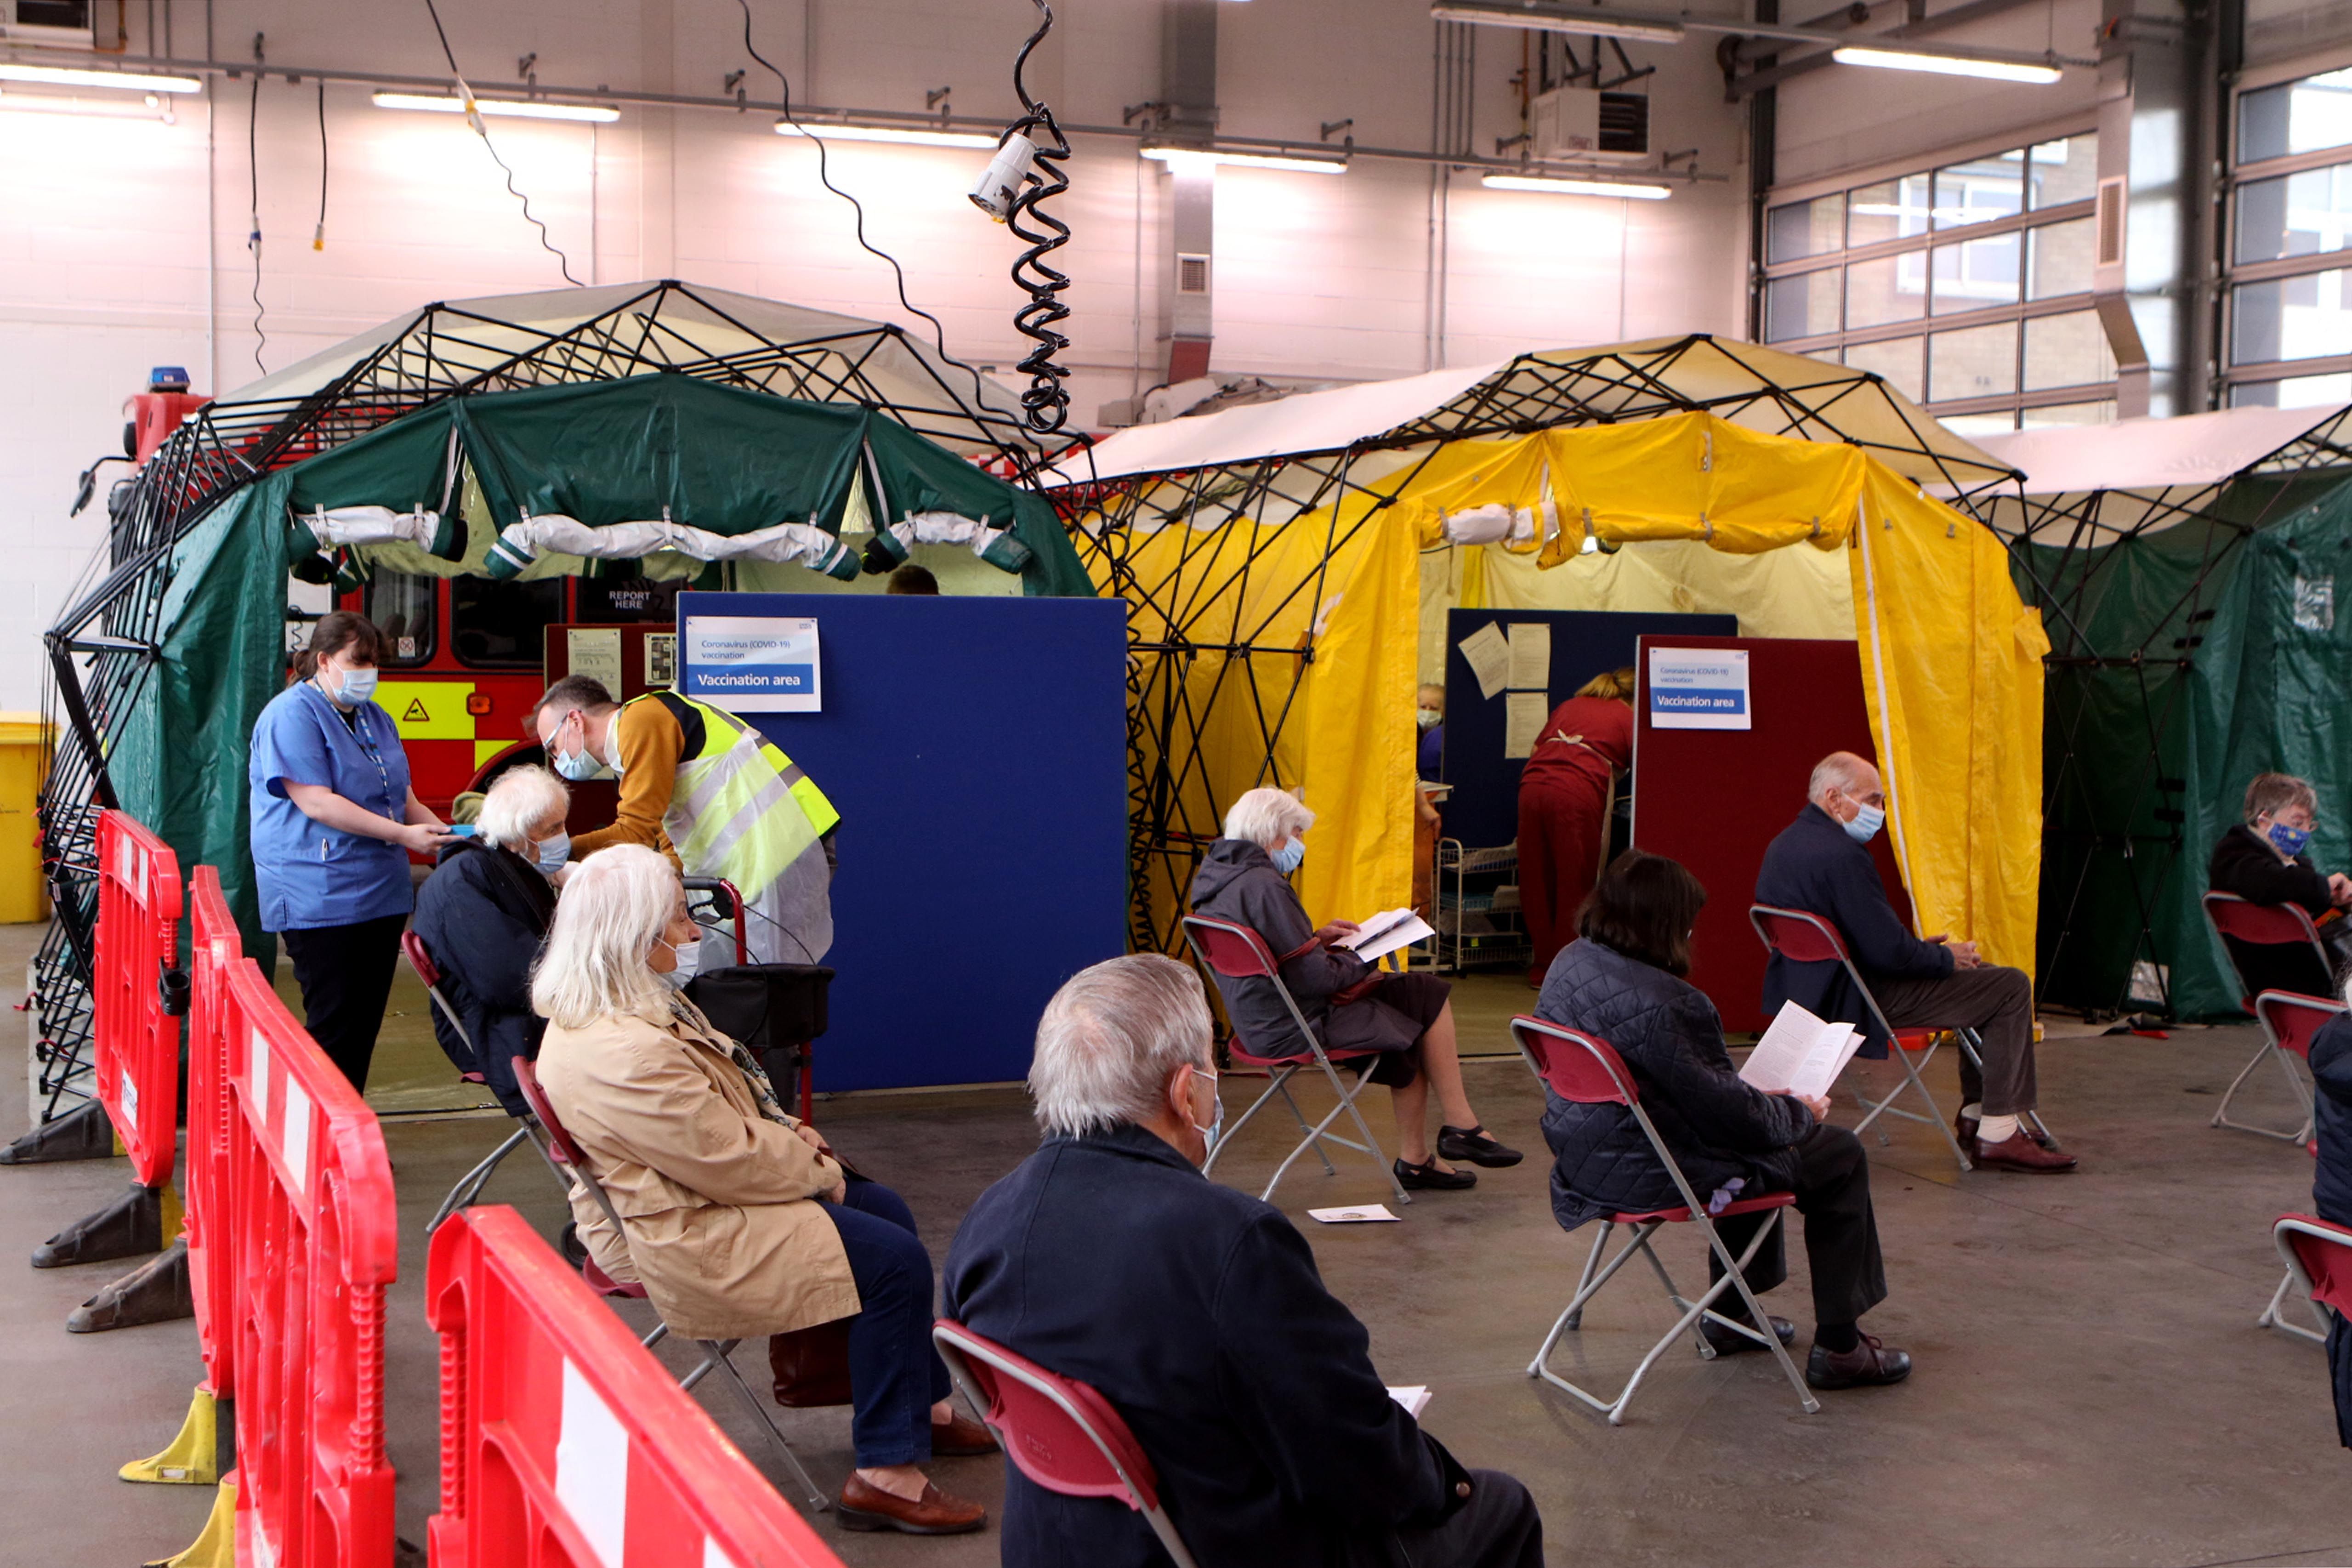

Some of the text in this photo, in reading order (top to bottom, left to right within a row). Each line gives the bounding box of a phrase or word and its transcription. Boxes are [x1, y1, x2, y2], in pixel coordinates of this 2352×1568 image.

[609, 591, 651, 600] REPORT
[615, 600, 642, 608] HERE
[750, 640, 790, 649] (COVID-19)
[698, 674, 801, 686] Vaccination area
[1657, 695, 1735, 707] Vaccination area
